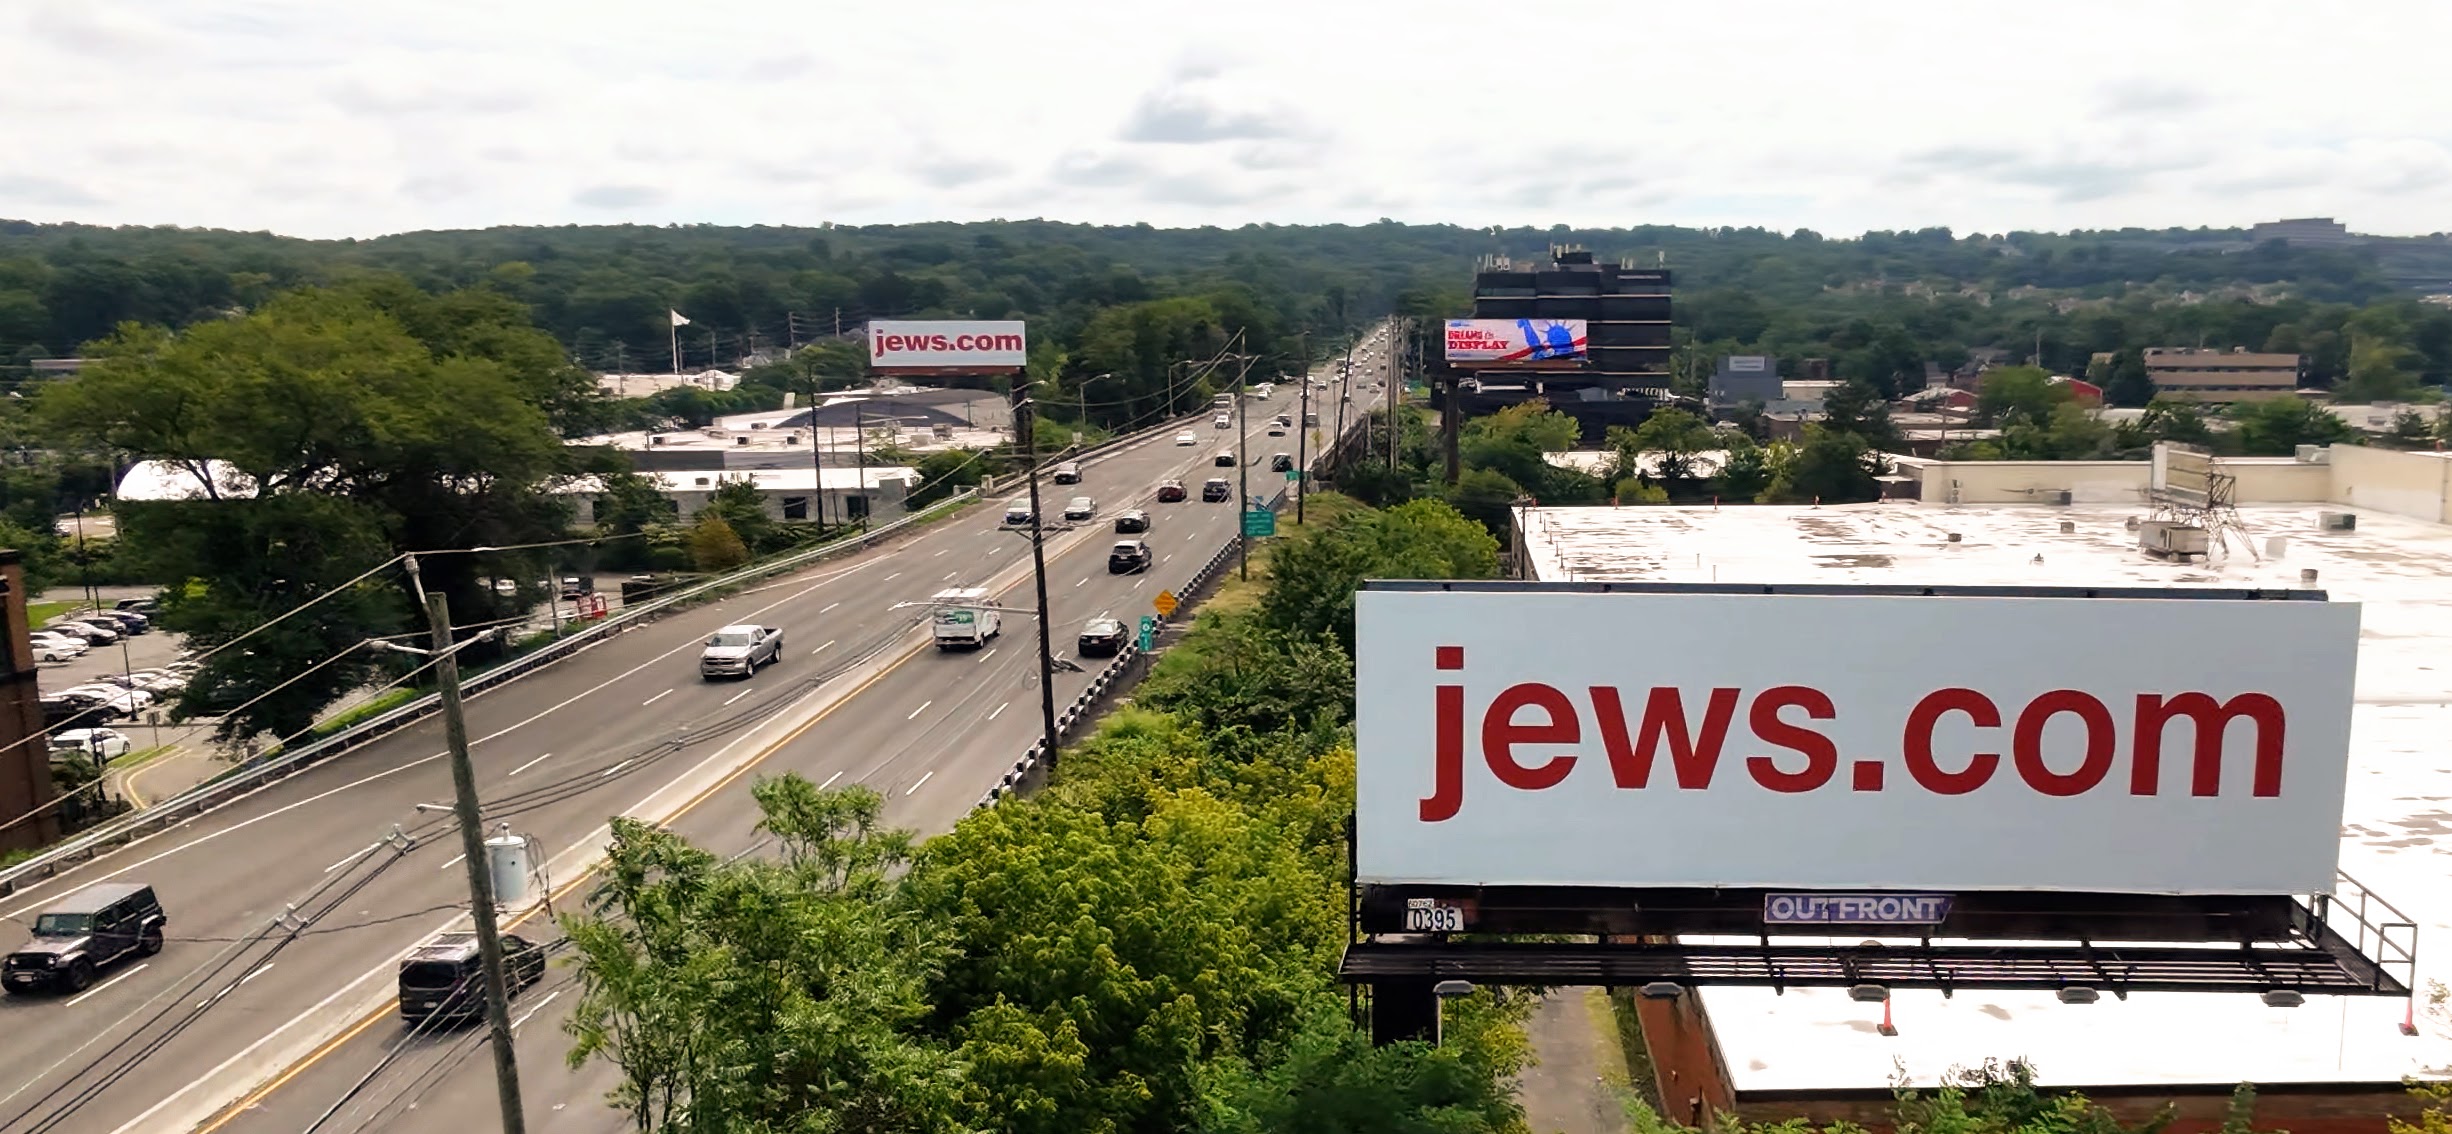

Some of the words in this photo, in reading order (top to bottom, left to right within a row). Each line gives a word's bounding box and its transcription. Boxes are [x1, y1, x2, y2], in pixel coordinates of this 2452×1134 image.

[875, 329, 1023, 358] jews.com
[1448, 341, 1509, 350] DISPLAY
[1420, 646, 2286, 822] jews.com
[1413, 908, 1456, 930] 0395
[1771, 896, 1944, 920] OUTFRONT
